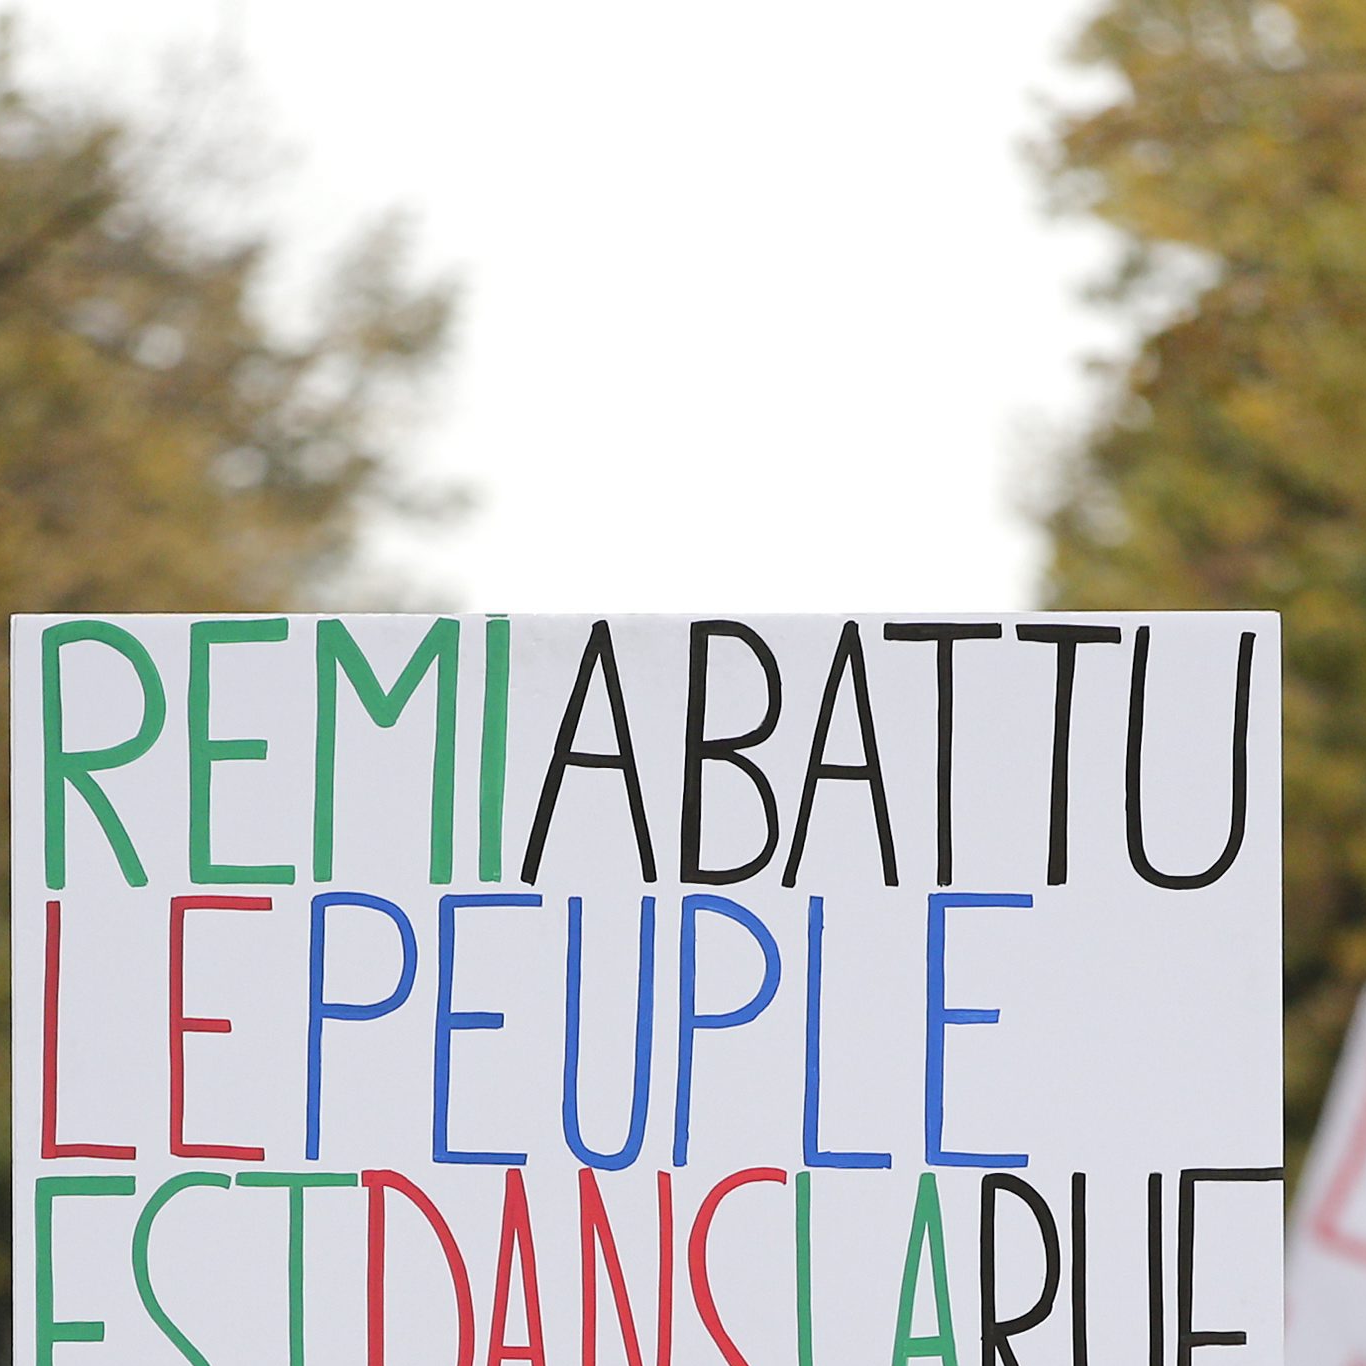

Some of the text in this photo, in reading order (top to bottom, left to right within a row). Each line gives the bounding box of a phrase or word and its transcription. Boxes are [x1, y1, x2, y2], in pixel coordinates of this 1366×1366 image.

[42, 617, 510, 889] REMI
[41, 891, 1035, 1172] LE PEUPLE
